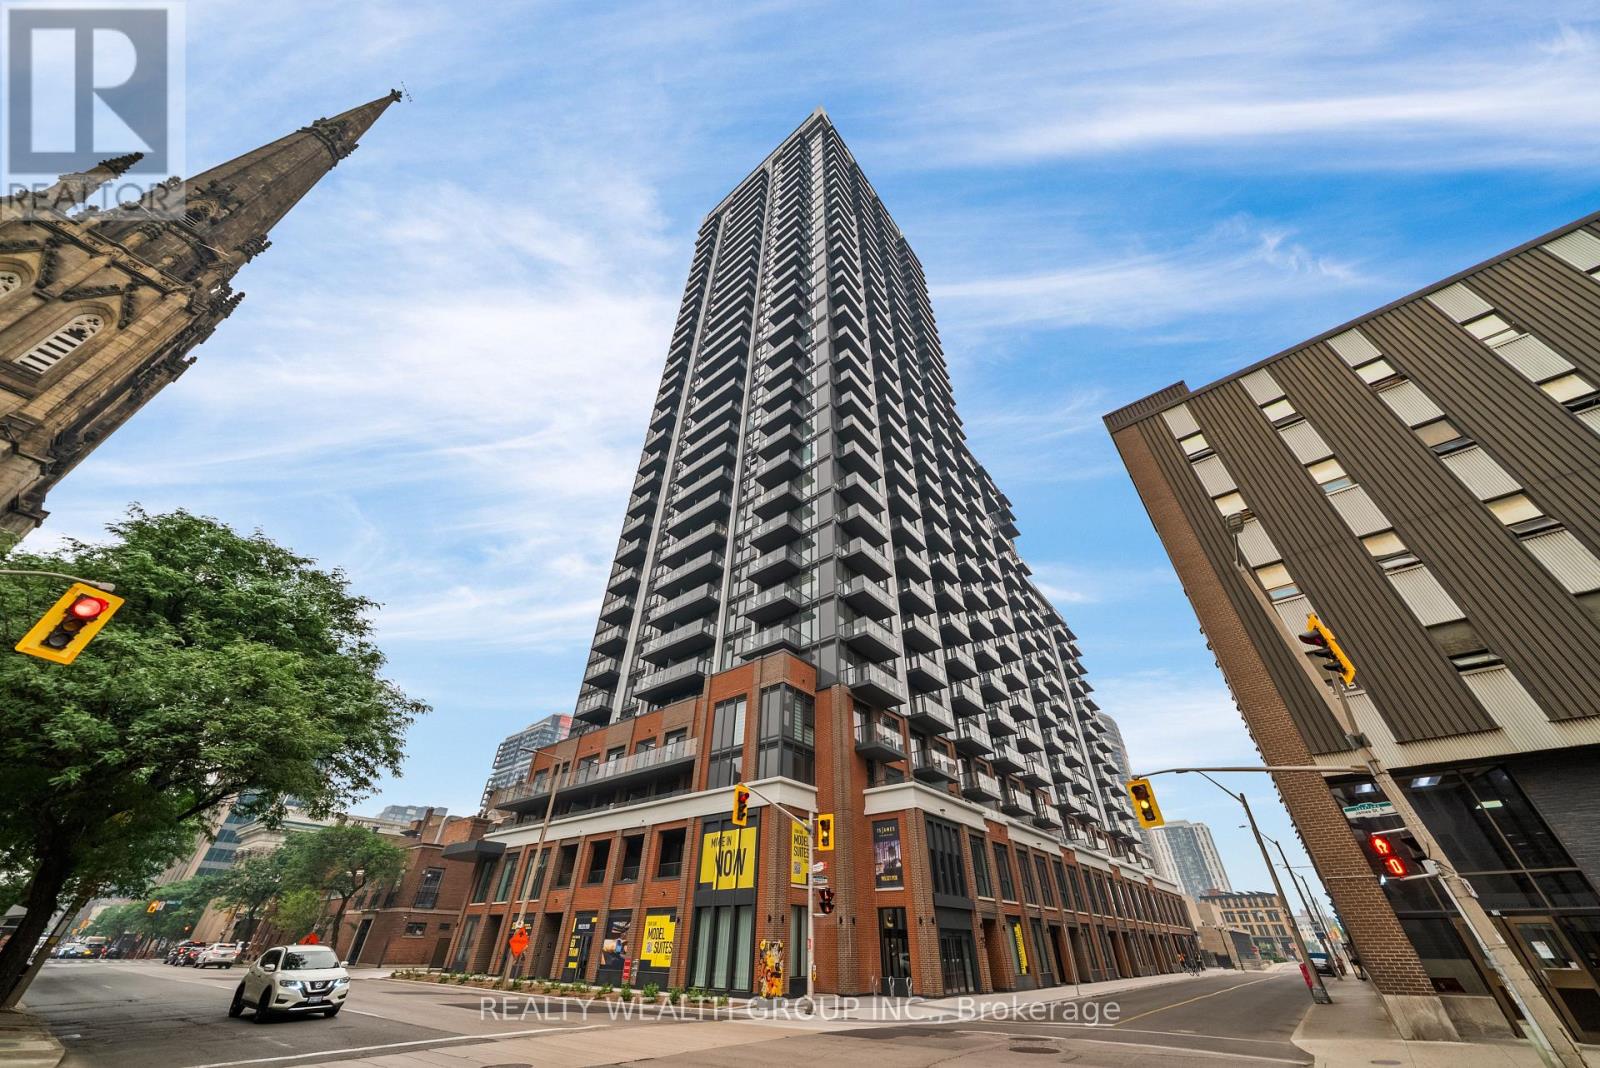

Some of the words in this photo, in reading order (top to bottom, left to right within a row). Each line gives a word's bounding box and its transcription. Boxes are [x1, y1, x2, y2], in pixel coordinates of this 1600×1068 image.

[715, 847, 747, 877] NOW
[647, 927, 665, 940] MODEL
[653, 941, 673, 954] SUITES
